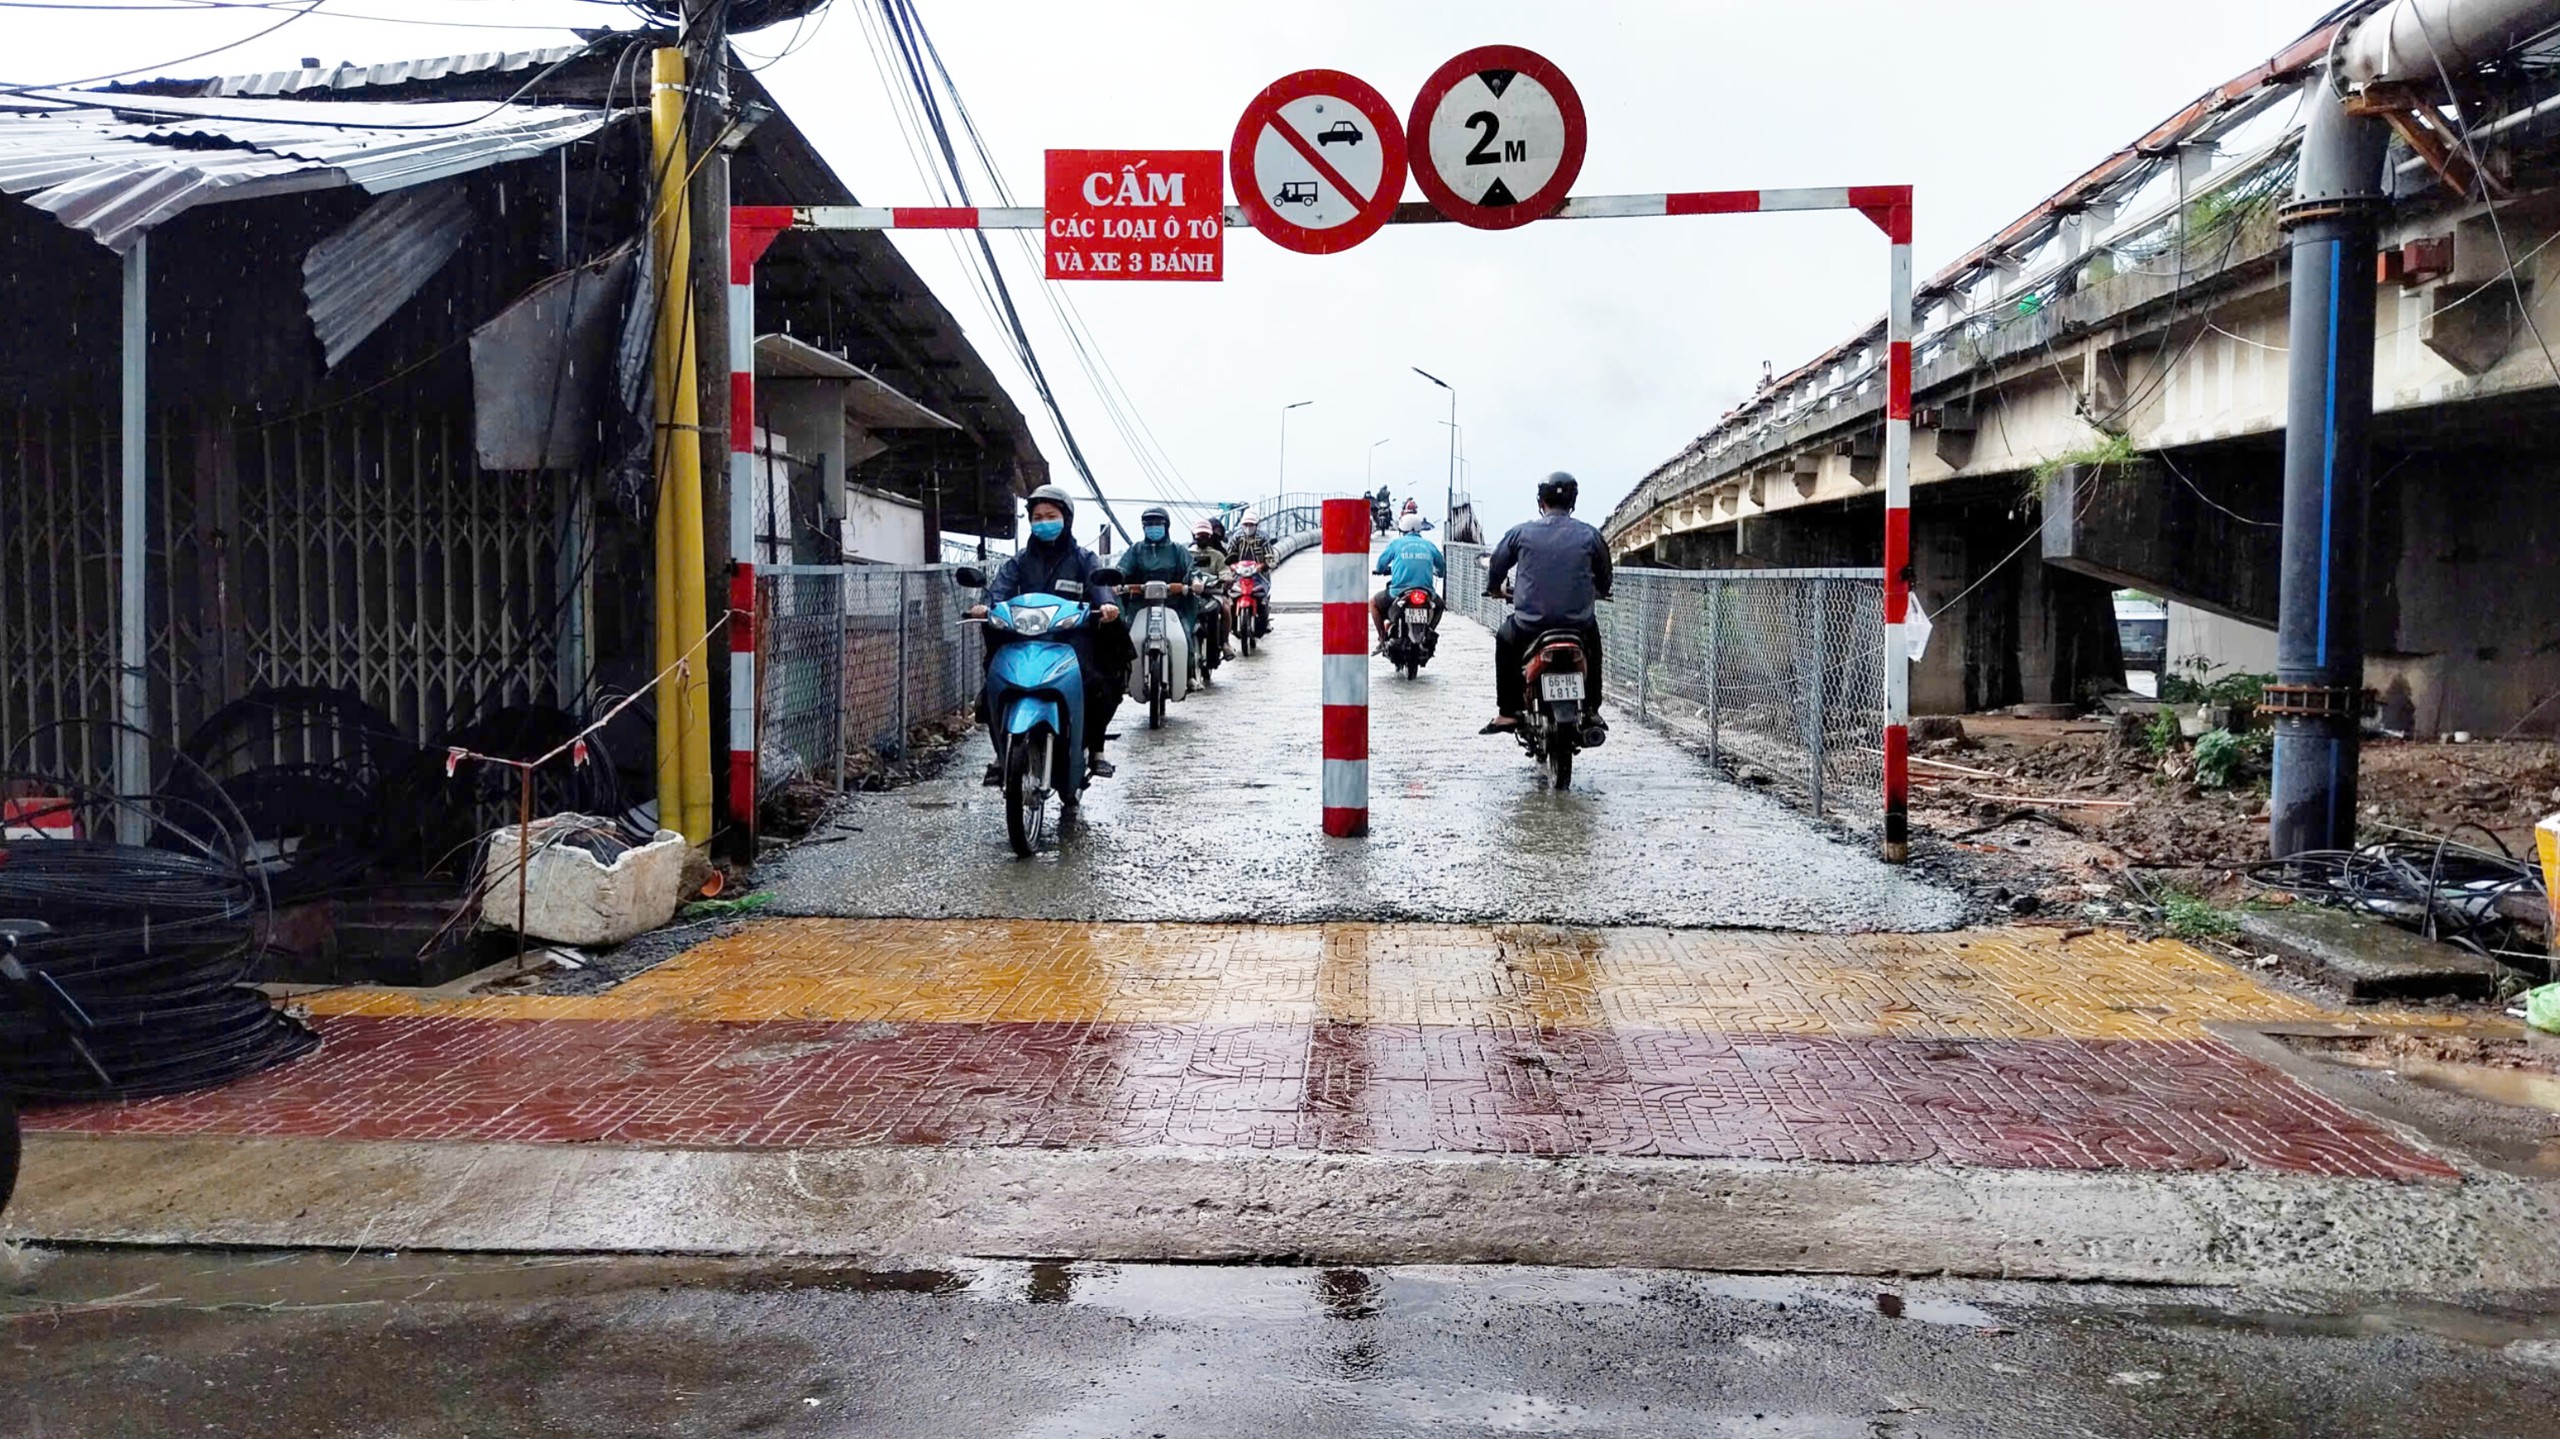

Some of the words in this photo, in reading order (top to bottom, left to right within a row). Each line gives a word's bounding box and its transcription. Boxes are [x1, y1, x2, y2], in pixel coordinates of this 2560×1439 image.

[1082, 159, 1186, 207] CẤM
[1050, 212, 1095, 238] CÁC
[1103, 218, 1156, 242] LOẠI
[1163, 215, 1180, 239] Ô
[1187, 215, 1218, 239] TÔ
[1055, 246, 1085, 271] VÀ
[1090, 252, 1121, 271] XE
[1128, 252, 1143, 272] 3
[1150, 246, 1214, 272] BÁNH
[1550, 687, 1579, 698] 4815
